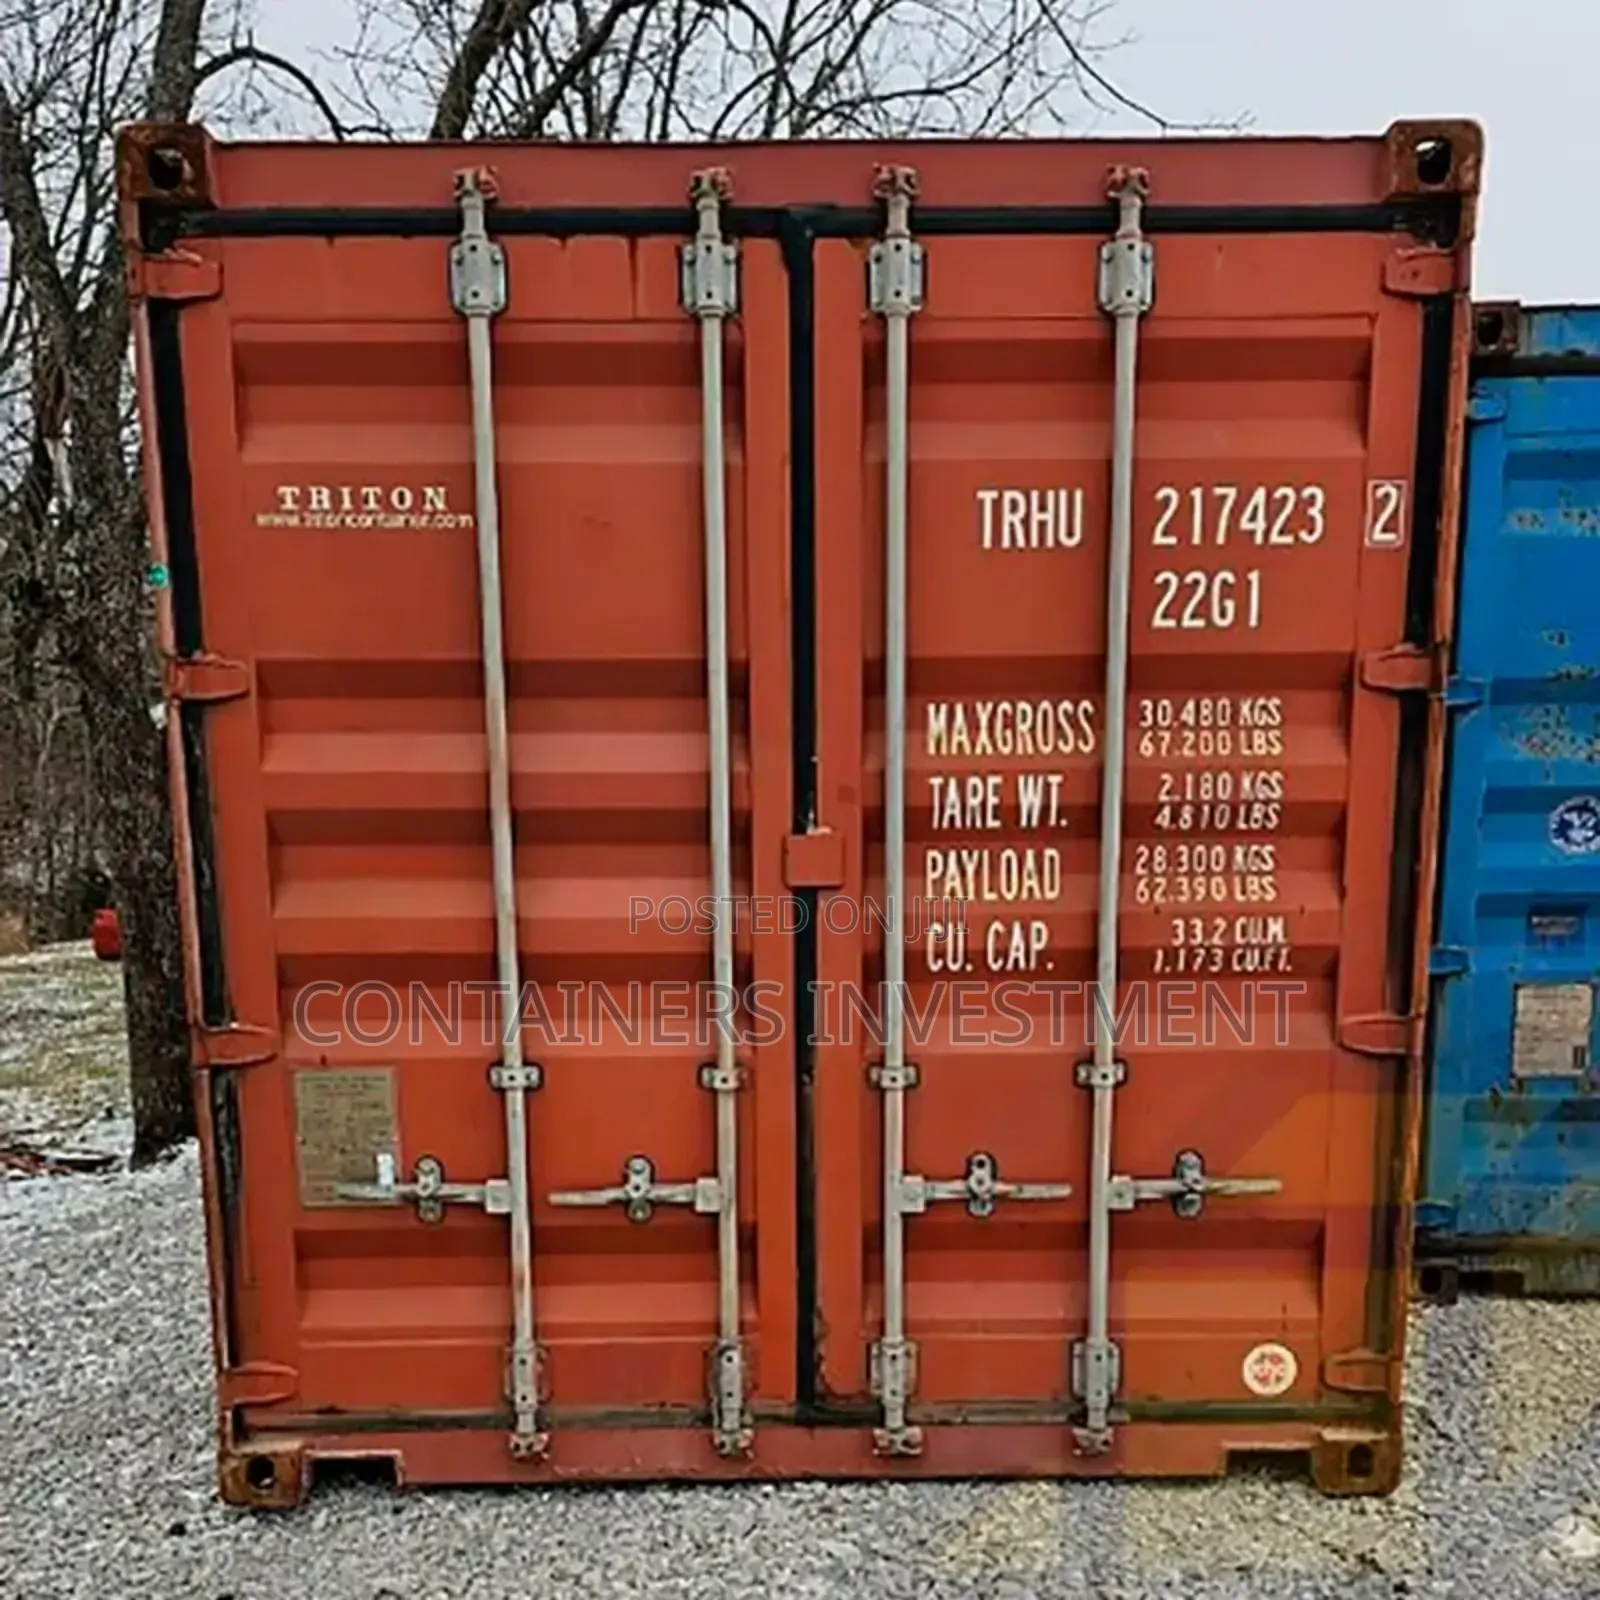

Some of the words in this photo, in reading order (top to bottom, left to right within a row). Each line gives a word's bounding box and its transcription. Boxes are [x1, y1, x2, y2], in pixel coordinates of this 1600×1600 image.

[277, 485, 448, 511] TRITON
[977, 489, 1083, 549] TRHU
[1152, 486, 1324, 545] 217423
[1372, 485, 1399, 542] 2
[1152, 570, 1260, 628] 22G1
[1138, 698, 1230, 727] 30.480
[1239, 698, 1282, 727] KGS
[926, 700, 1096, 756] MAXGROSS
[1138, 730, 1232, 757] 67.200
[1240, 730, 1283, 757] LBS
[1157, 772, 1232, 801] 2.180
[1239, 772, 1284, 801] KGS
[929, 775, 1002, 829] TARE
[1018, 775, 1068, 829] WT.
[1154, 804, 1228, 830] 4.810
[1236, 804, 1281, 830] LBS
[1134, 845, 1226, 874] 28.300
[1233, 845, 1276, 874] KGS
[925, 849, 1061, 902] PAYLOAD
[1134, 875, 1226, 903] 62.390
[1233, 875, 1277, 903] LBS
[927, 921, 972, 972] CU.
[987, 921, 1055, 972] CAP.
[1170, 918, 1227, 946] 33.2
[1153, 947, 1224, 973] 1.173
